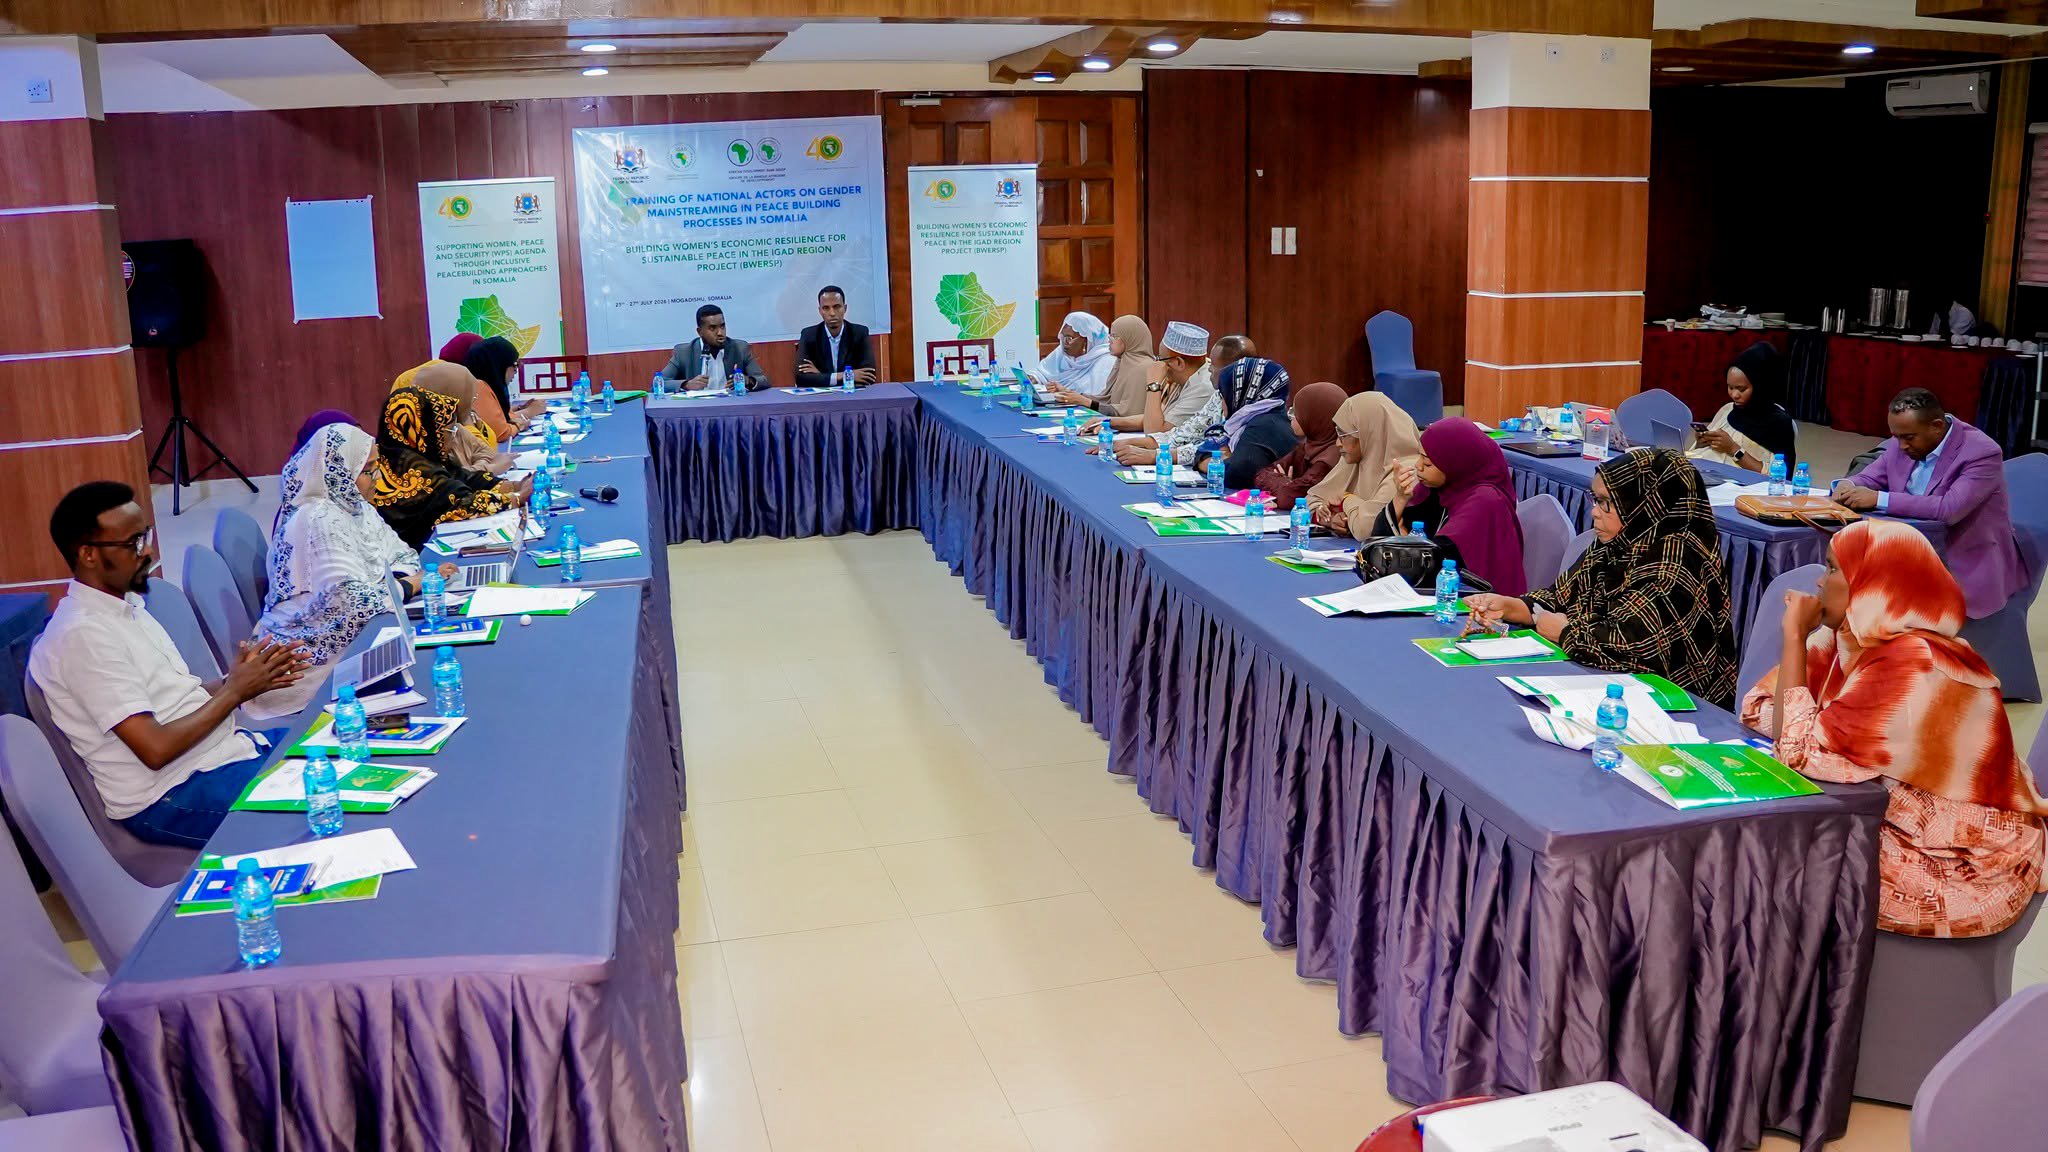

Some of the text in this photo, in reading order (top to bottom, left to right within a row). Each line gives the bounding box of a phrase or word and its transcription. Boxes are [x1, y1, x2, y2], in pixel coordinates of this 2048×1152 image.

[626, 185, 862, 206] TRAINING OF NATIONAL ACTORS ON GENDER
[647, 199, 841, 217] MAINSTREAMING IN PEACE BUILDING
[683, 213, 808, 228] PROCESSES IN SOMALIA
[988, 221, 1028, 229] ECONOMIC
[920, 230, 960, 238] RESILIENCE
[977, 229, 1025, 237] SUSTAINABLE
[436, 238, 544, 251] SUPPORTING WOMEN, PEACE
[626, 233, 846, 254] BUILDING WOMEN'S ECONOMIC RESILIENCE FOR
[924, 239, 947, 247] PEACE
[974, 238, 992, 246] IGAD
[435, 247, 547, 260] AND SECURITY (WPS) AGENDA
[641, 245, 832, 264] SUSTAINABLE PEACE IN THE IGAD REGION
[974, 247, 1007, 255] (BWERSP)
[453, 257, 531, 269] THROUGH INCLUSIVE
[697, 259, 783, 272] PROJECT (BWERSP)
[436, 265, 548, 278] PEACEBUILDING APPROACHES
[482, 276, 517, 285] SOMALIA
